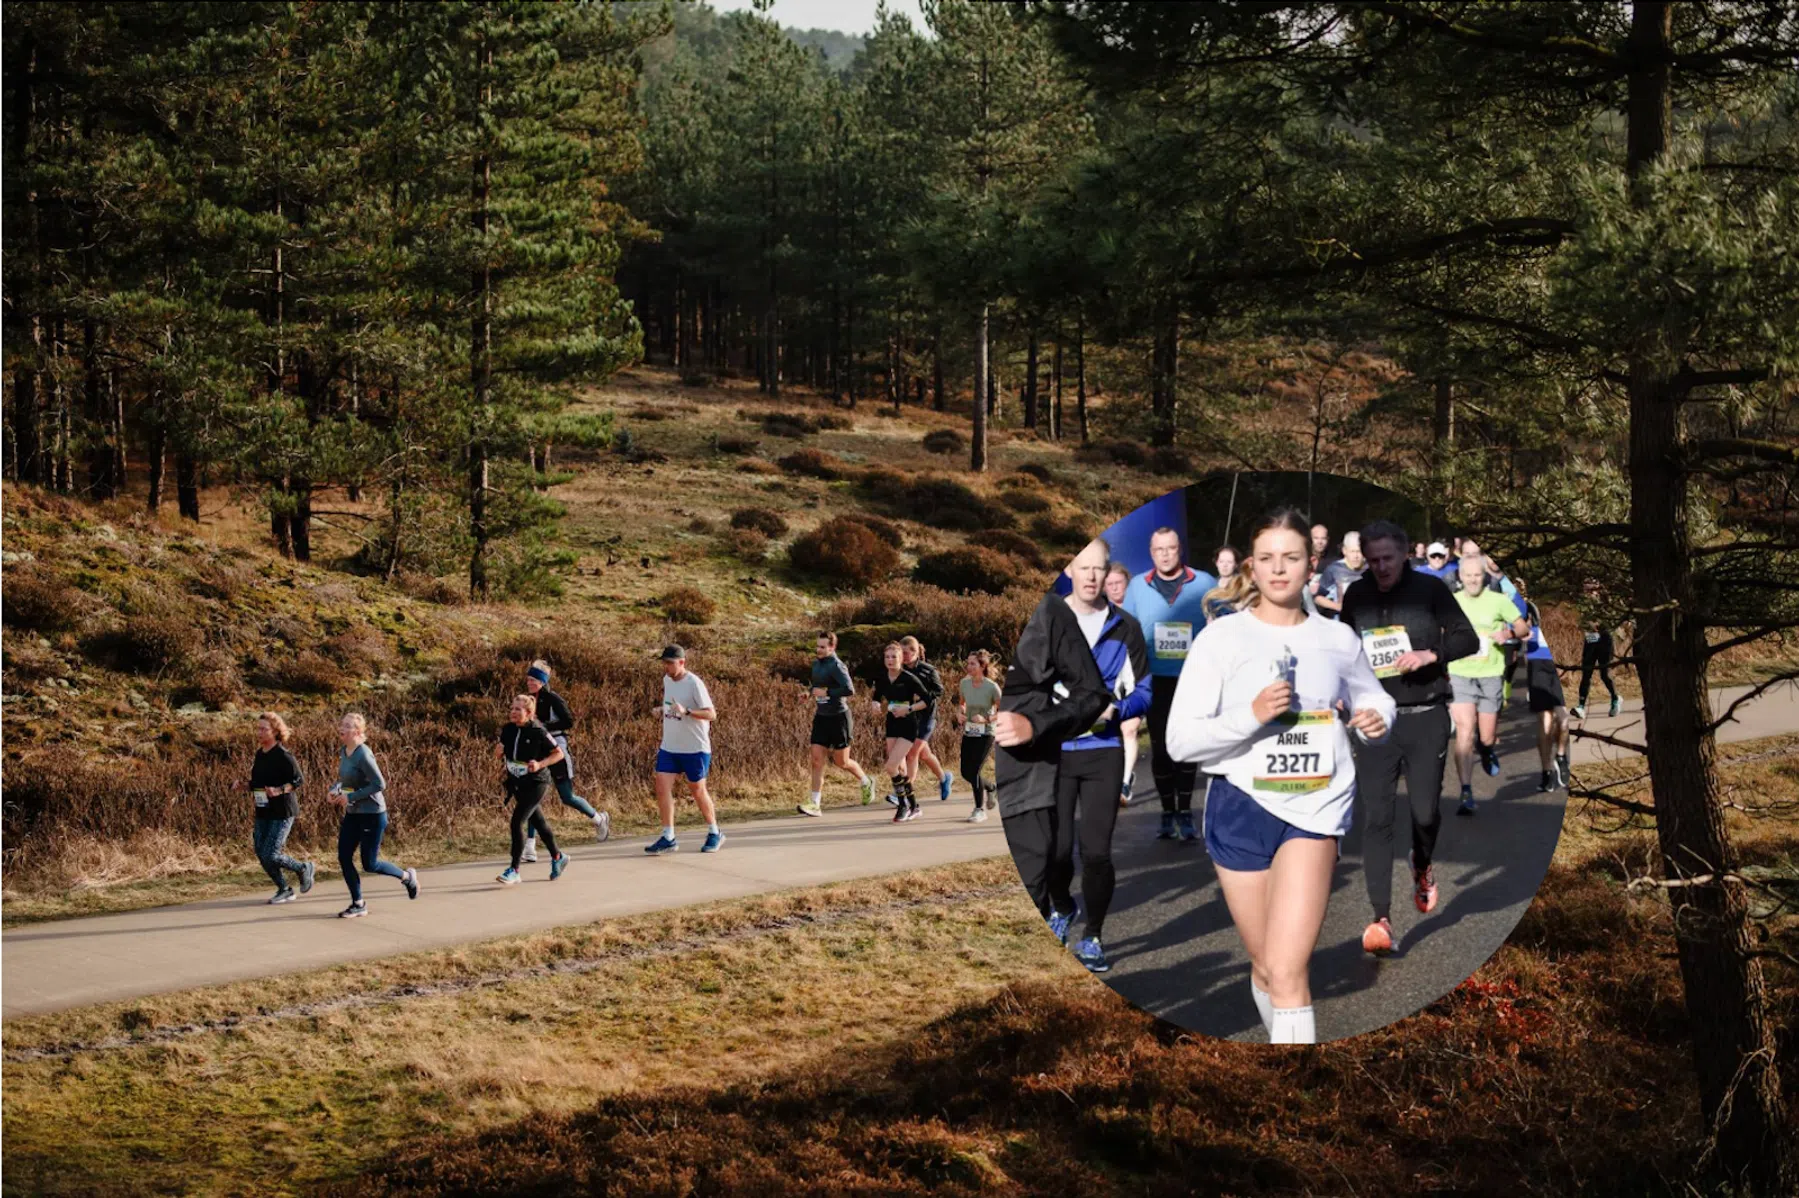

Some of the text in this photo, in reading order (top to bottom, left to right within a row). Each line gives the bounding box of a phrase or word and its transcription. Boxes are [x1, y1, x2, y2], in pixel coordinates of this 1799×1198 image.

[1373, 638, 1399, 649] ENRICO
[1276, 732, 1309, 746] ARNE
[1265, 752, 1321, 774] 23277
